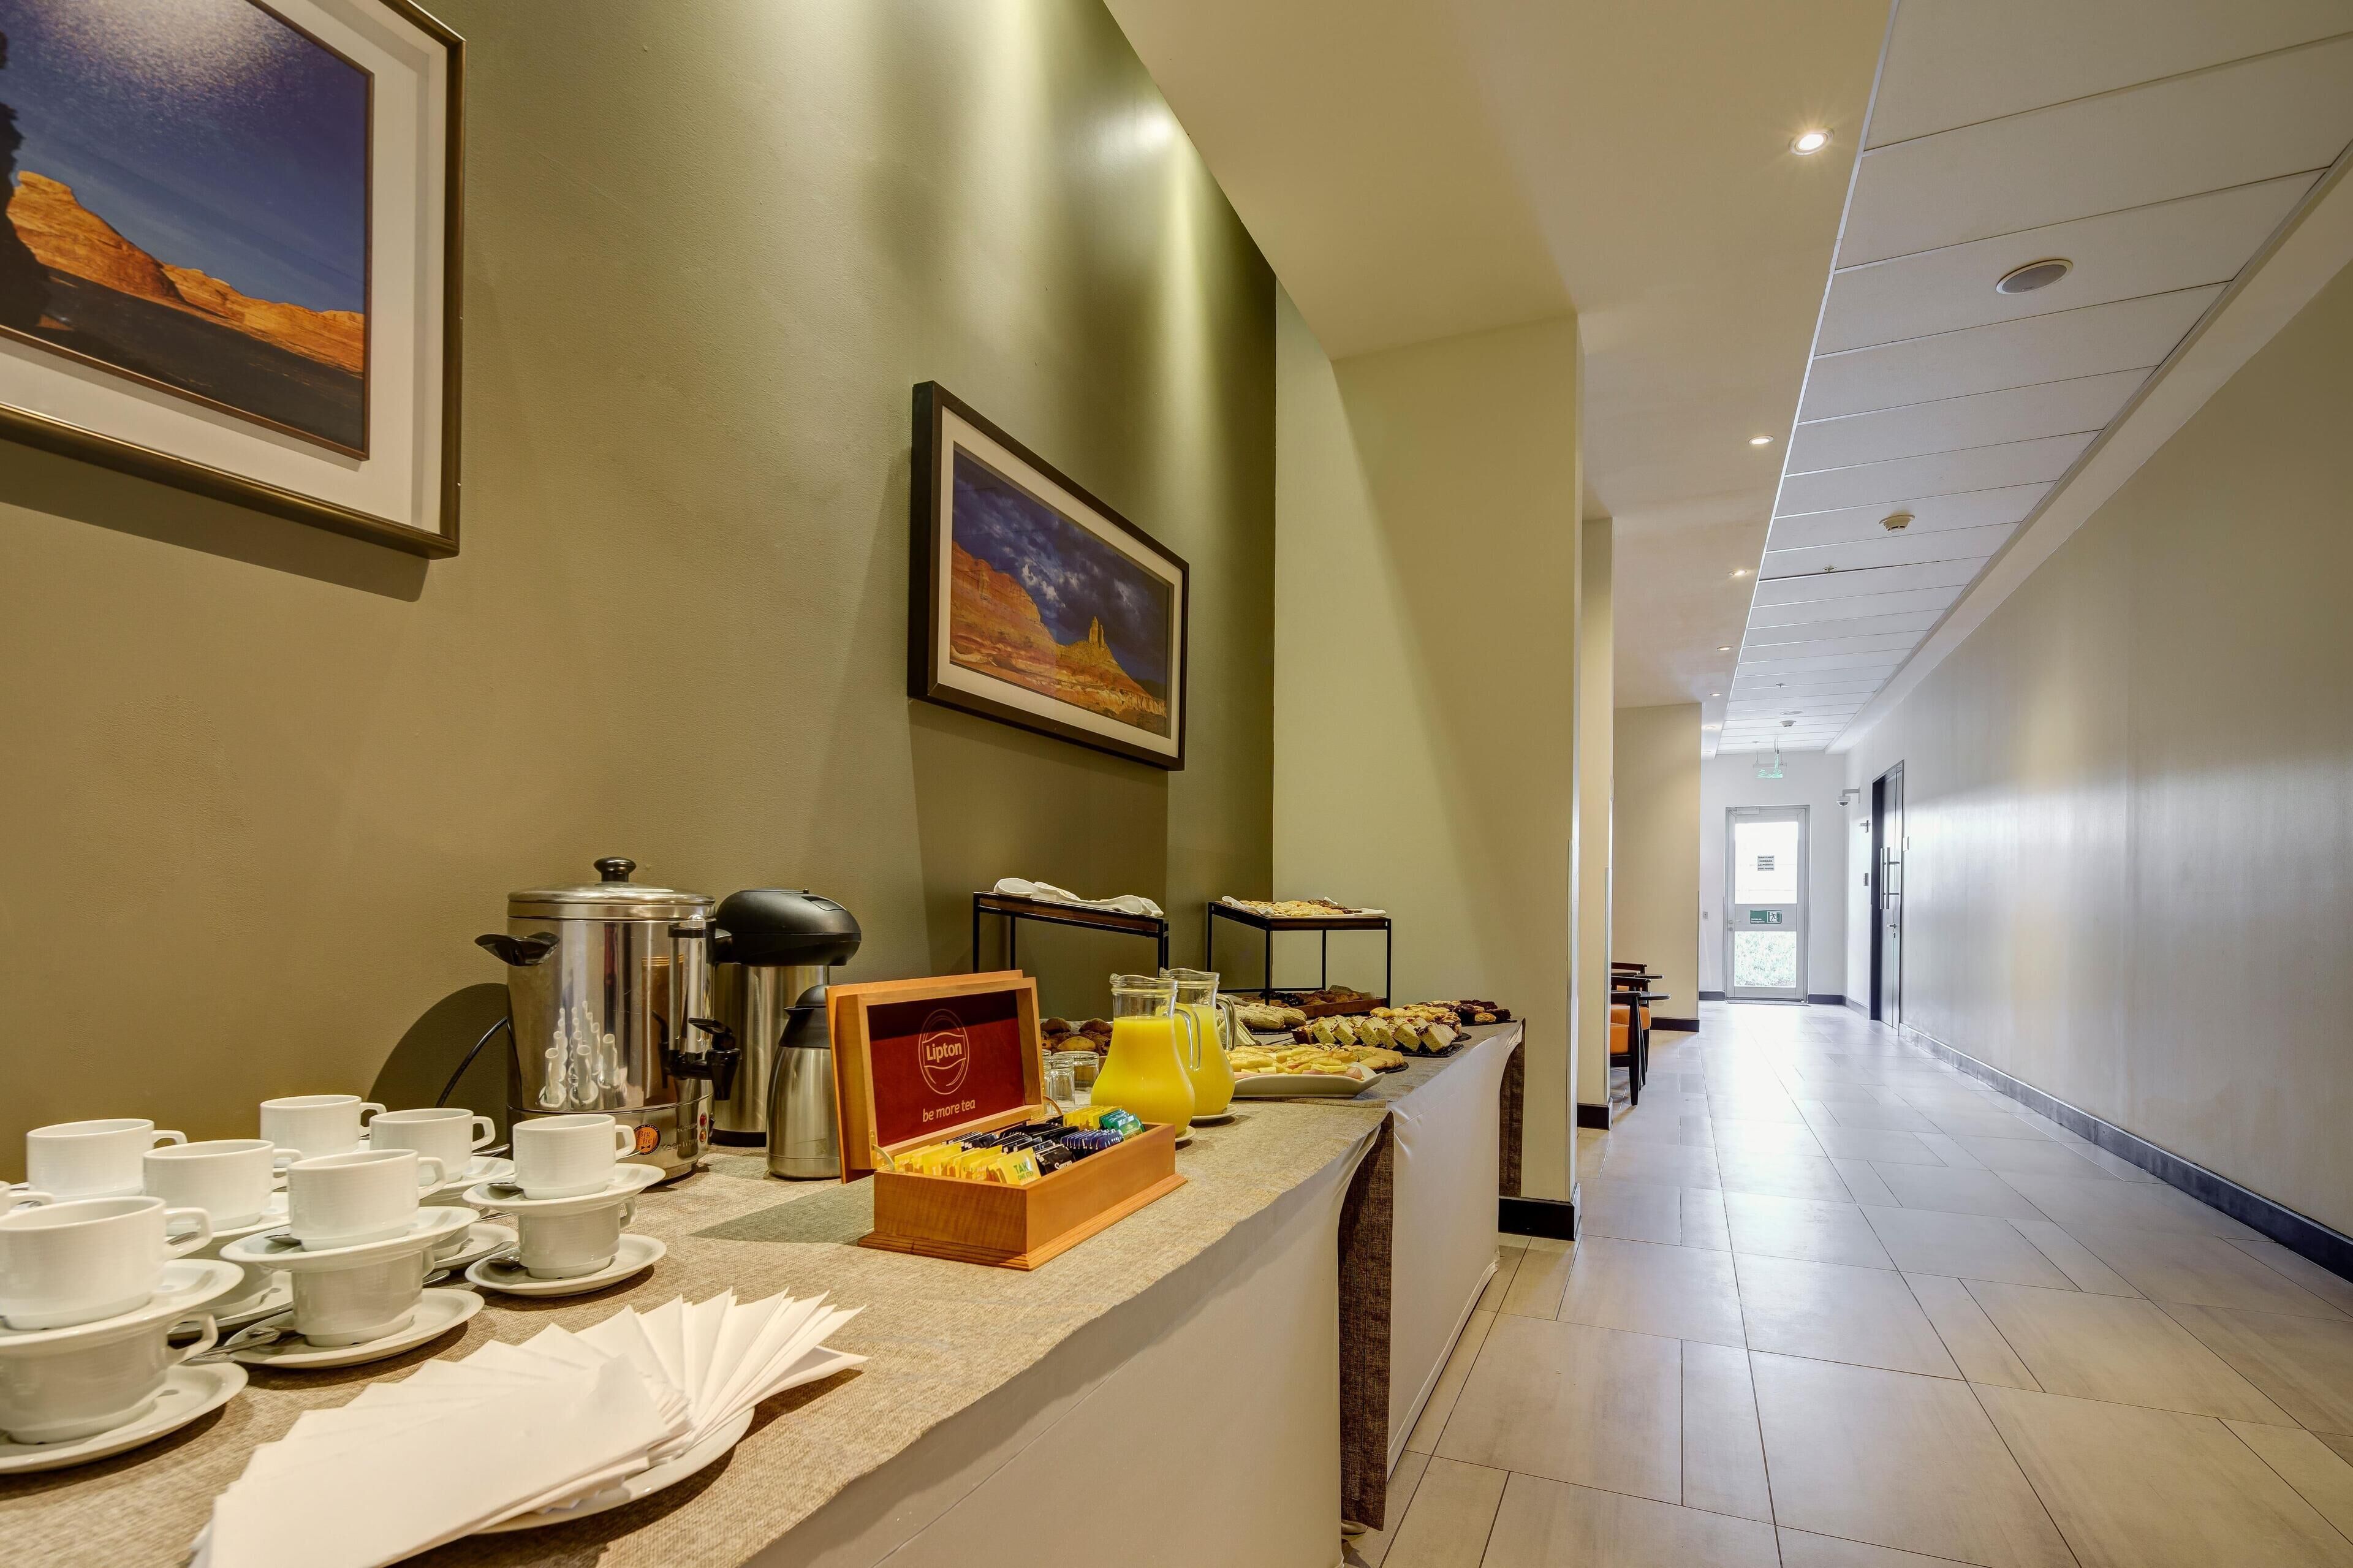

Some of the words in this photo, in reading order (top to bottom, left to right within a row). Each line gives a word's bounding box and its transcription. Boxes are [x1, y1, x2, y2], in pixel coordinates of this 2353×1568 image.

[926, 1043, 962, 1063] Lipton
[922, 1108, 934, 1123] be
[936, 1104, 960, 1119] more
[961, 1099, 976, 1112] tea
[1014, 1161, 1033, 1174] TAK
